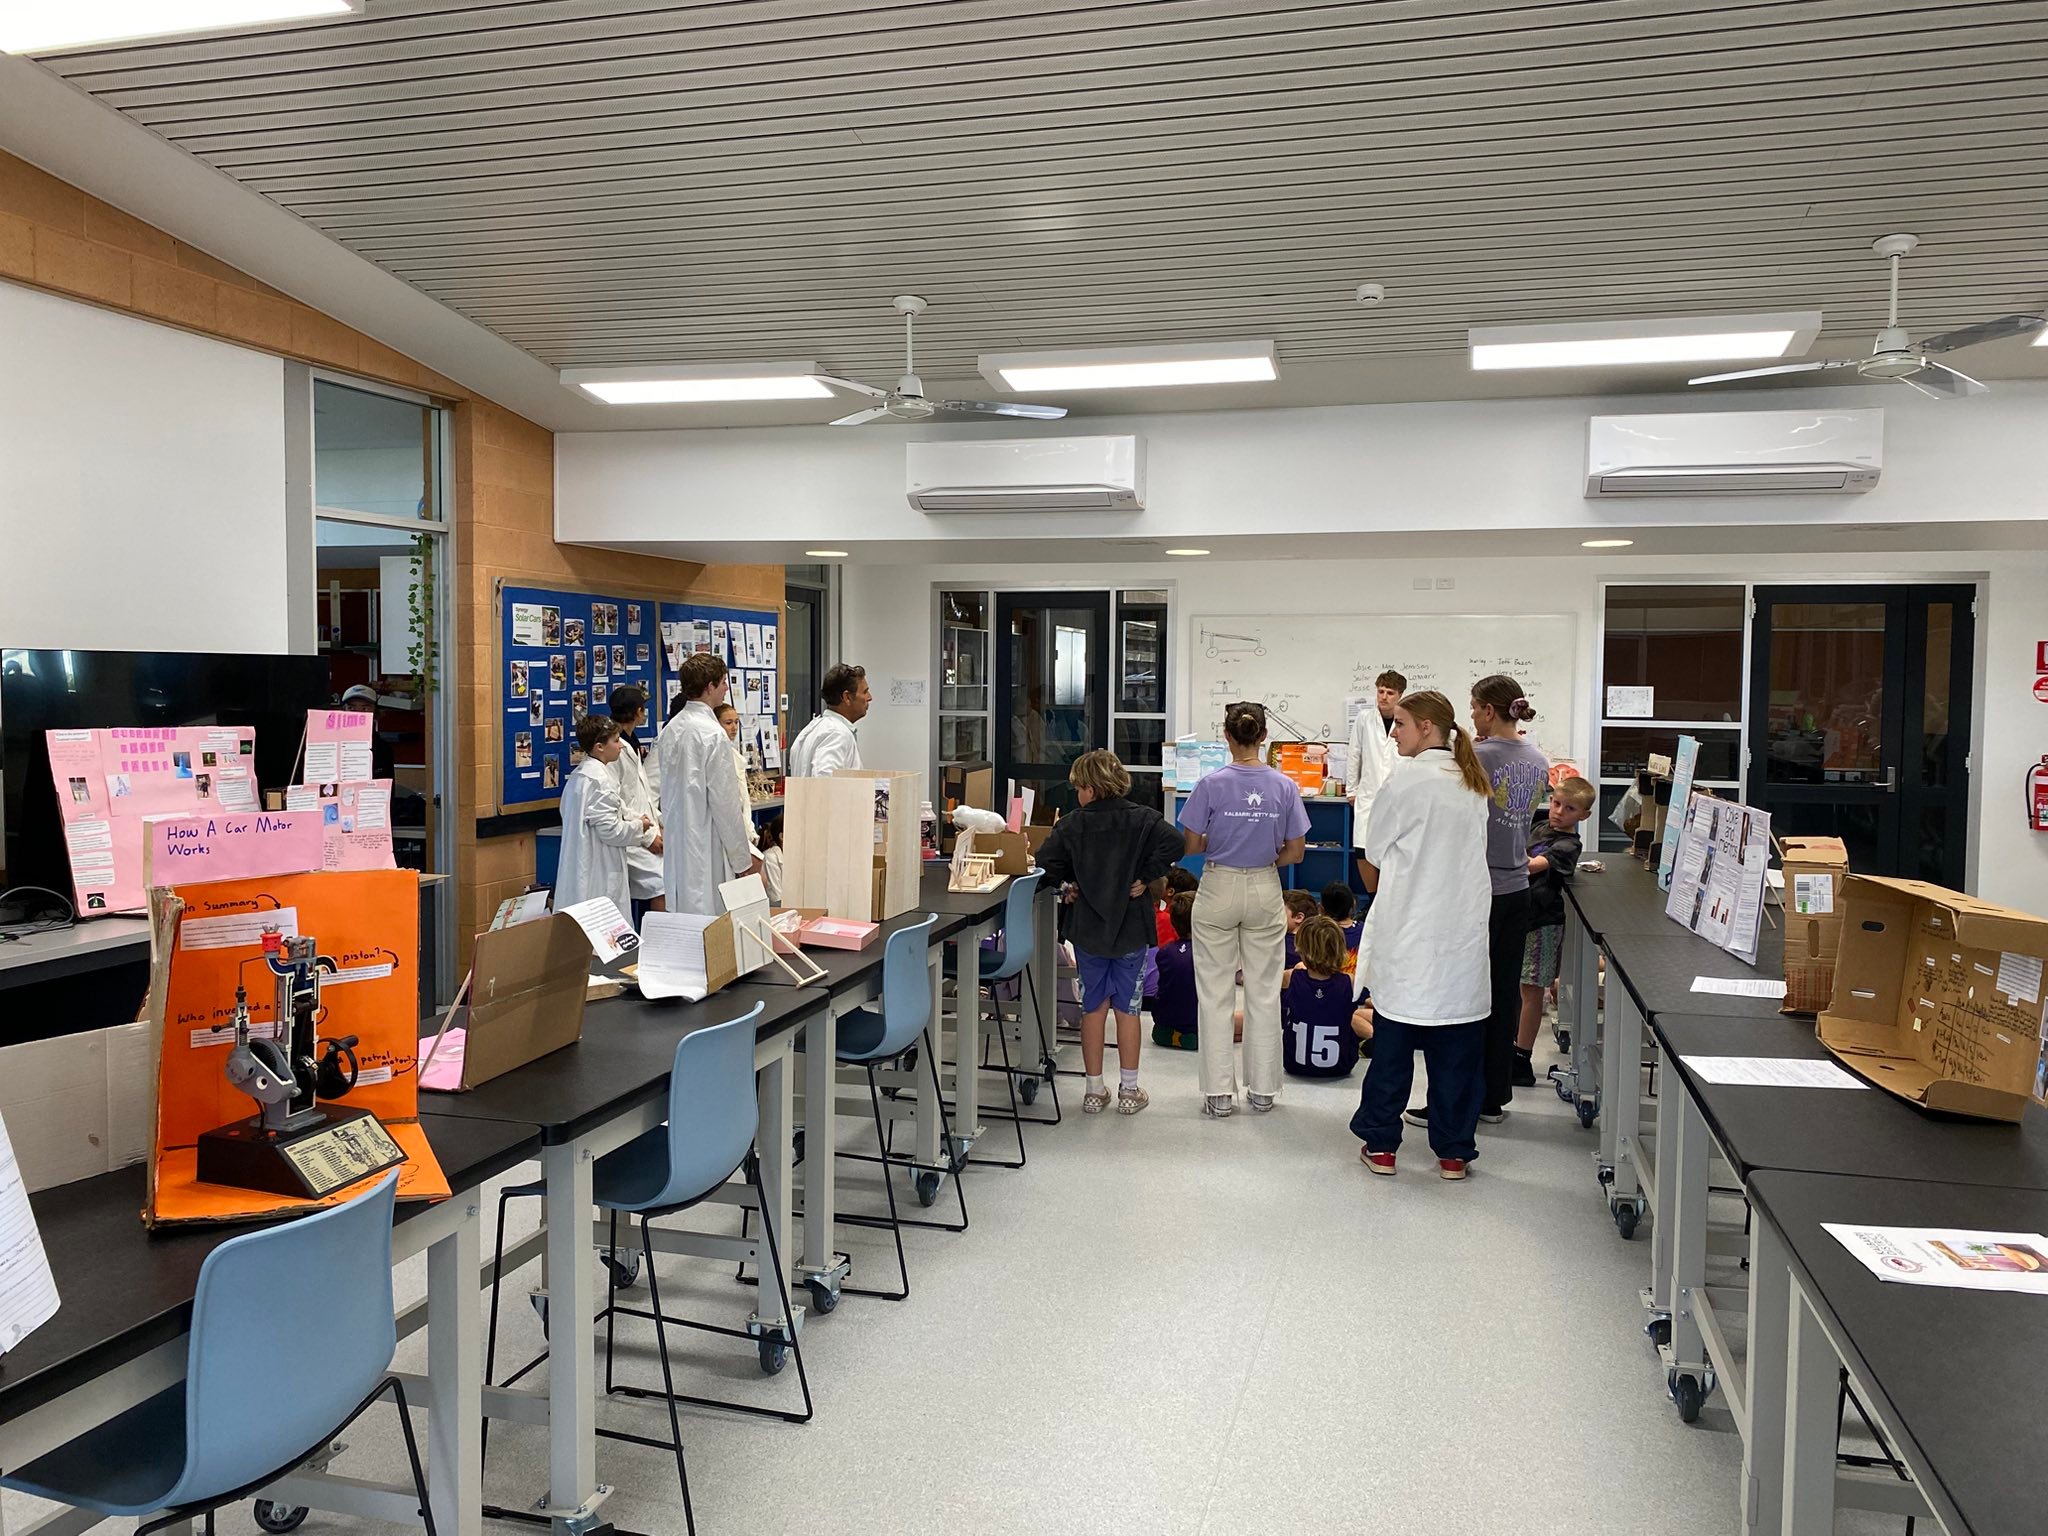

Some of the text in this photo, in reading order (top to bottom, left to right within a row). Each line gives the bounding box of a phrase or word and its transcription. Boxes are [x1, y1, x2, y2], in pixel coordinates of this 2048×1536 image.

[167, 816, 293, 841] How A Car Motor
[167, 843, 210, 856] Works
[184, 899, 259, 914] In Summary
[343, 946, 381, 964] piston?
[178, 1013, 206, 1024] Who
[1292, 1021, 1340, 1068] 15
[361, 1050, 390, 1065] petrol
[381, 1055, 411, 1066] motor?
